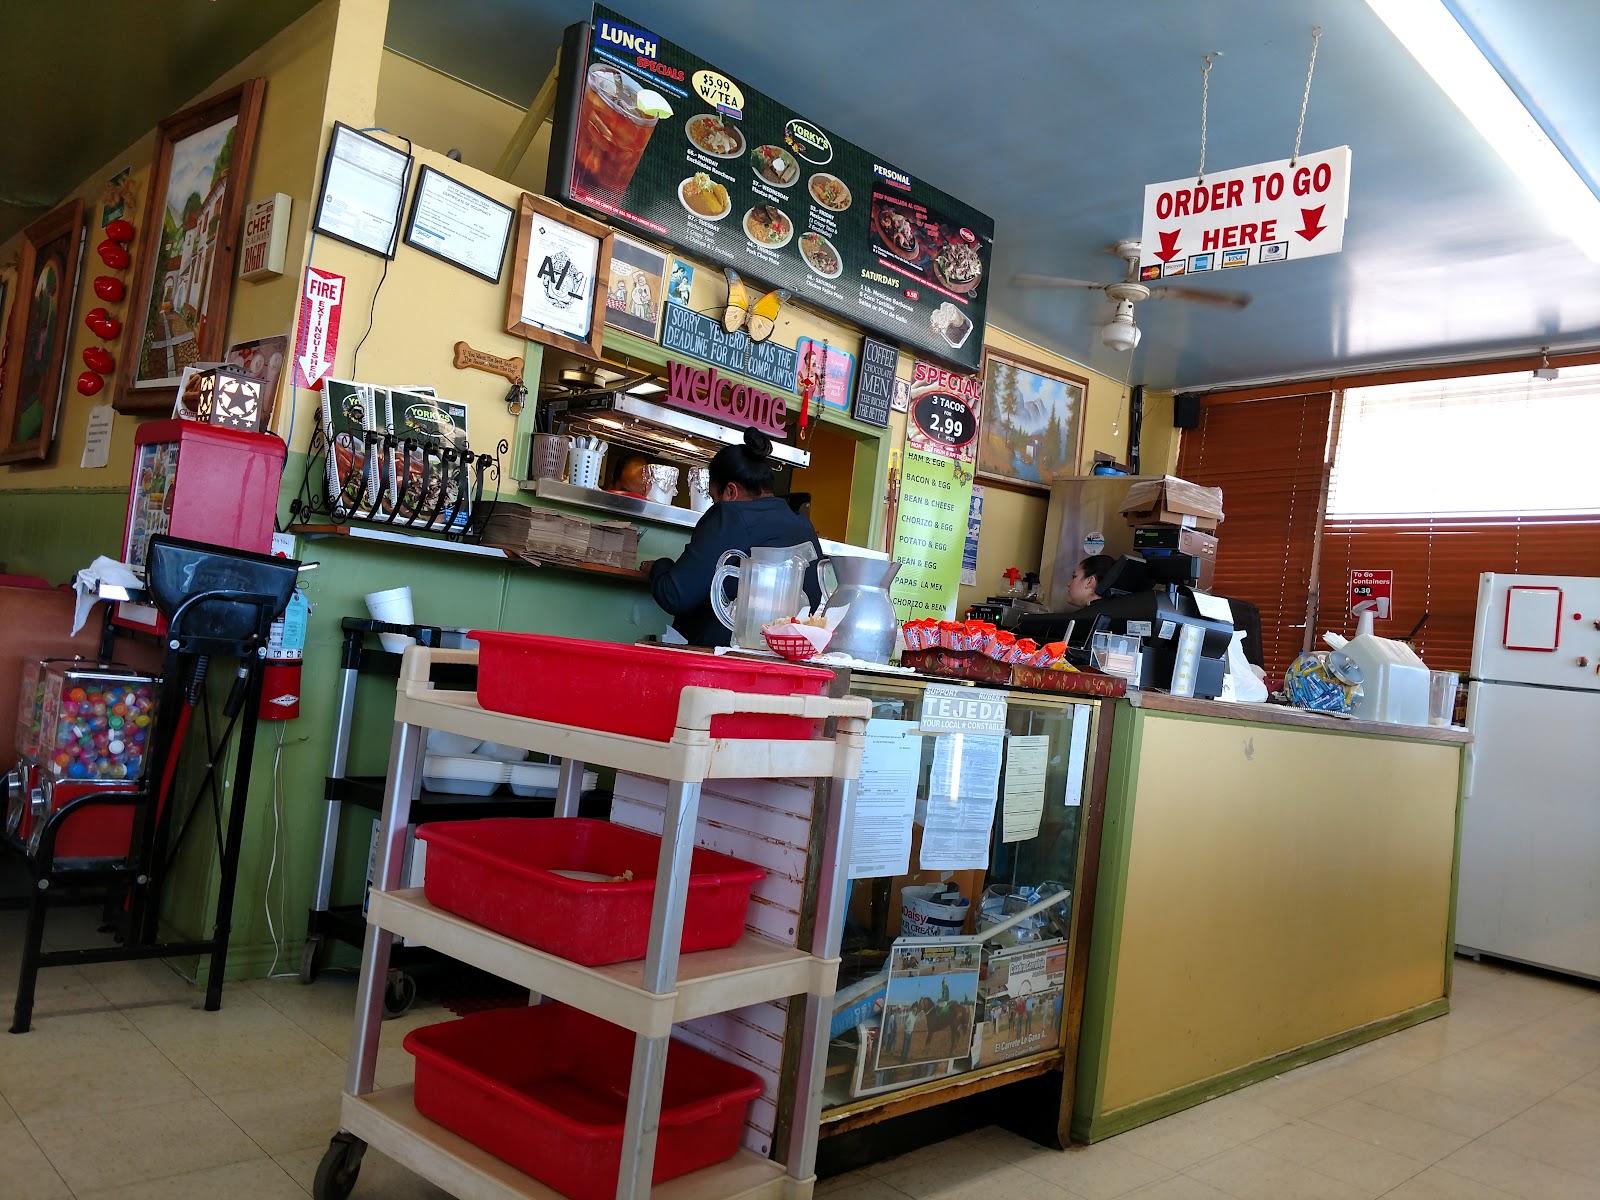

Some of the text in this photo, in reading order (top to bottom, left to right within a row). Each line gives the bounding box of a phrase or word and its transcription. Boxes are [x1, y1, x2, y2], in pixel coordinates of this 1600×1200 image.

[600, 22, 657, 58] LUNCH
[636, 56, 684, 81] SPECIALS
[703, 73, 730, 92] $5.99
[792, 122, 829, 149] YORKY'S
[698, 153, 719, 167] MONDAY
[873, 163, 910, 185] PERSONAL
[1156, 163, 1332, 220] ORDER TO GO
[247, 214, 271, 236] CHEF
[1202, 219, 1277, 251] HERE
[250, 230, 270, 244] ALWAYS
[244, 242, 267, 273] RIGHT
[1228, 254, 1243, 262] VISA
[537, 256, 556, 284] A
[861, 269, 899, 288] SATURDAYS
[309, 279, 338, 301] FIRE
[906, 291, 917, 299] 9.50
[308, 300, 326, 378] EXTINGUISHER
[672, 308, 705, 337] SORRY...
[758, 343, 775, 364] WAS
[778, 350, 792, 369] THE
[666, 326, 794, 388] DEADLINE FOR ALL COMPLAINTS
[866, 343, 895, 371] COFFEE,
[862, 372, 891, 402] MEN,
[915, 364, 980, 399] SPECIAL
[667, 360, 787, 430] welcome
[860, 393, 889, 410] THE RICHER
[931, 395, 965, 413] 3 TACOS
[858, 403, 887, 423] THE BETTER
[929, 414, 963, 437] 2.99
[908, 452, 924, 463] HAM
[932, 459, 946, 468] EGG
[906, 473, 930, 485] BACON
[938, 481, 951, 490] EGG
[904, 493, 955, 512] BEAN & CHEESE
[901, 514, 953, 532] CHORIZO & EGG
[899, 535, 927, 547] POTATO
[934, 542, 947, 551] EGG
[897, 556, 937, 570] BEAN & EGG
[894, 577, 917, 587] PAPAS
[930, 582, 943, 592] MEX
[892, 597, 947, 612] CHORIZO & BEAN
[925, 686, 998, 700] SUPPORT RUBEN
[924, 697, 1005, 720] TEJEDA
[921, 719, 1005, 731] YOUR LOCAL CONSTABLE
[903, 905, 927, 926] Daisy
[995, 1033, 1040, 1053] El Carrete Le Gana
